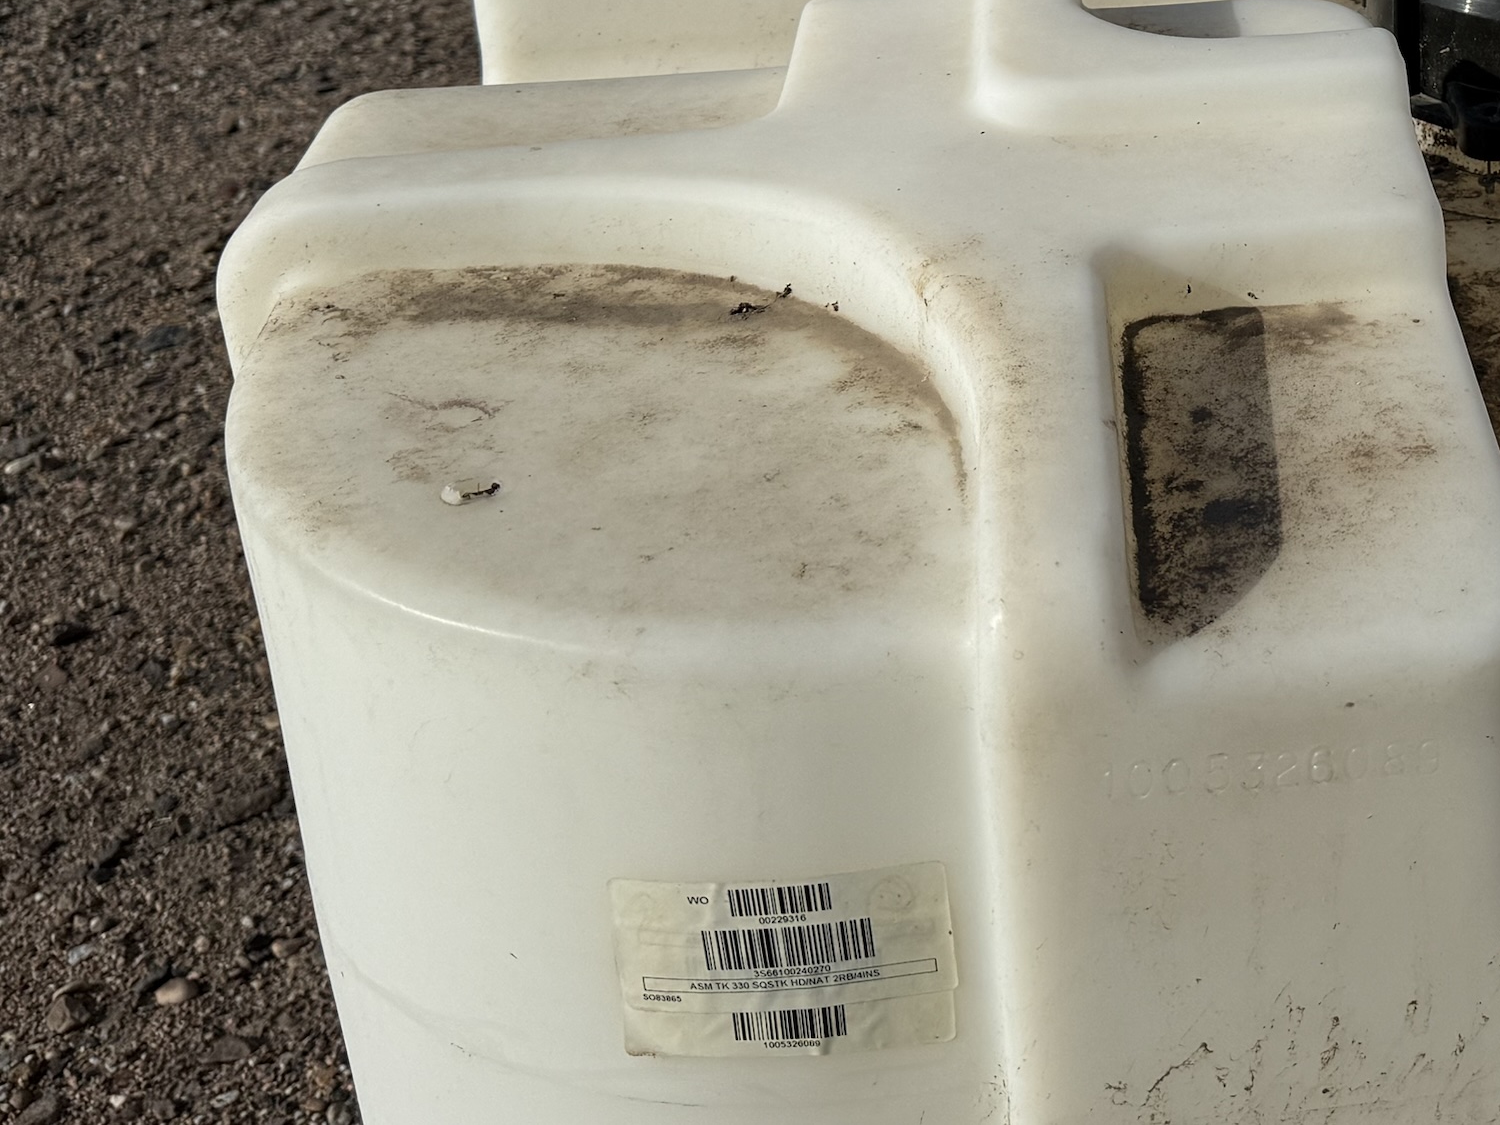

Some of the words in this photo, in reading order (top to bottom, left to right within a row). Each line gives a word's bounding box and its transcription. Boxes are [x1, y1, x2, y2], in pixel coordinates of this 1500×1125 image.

[687, 896, 709, 906] WO
[758, 914, 807, 925] 00229316
[690, 981, 714, 991] ASM
[715, 981, 730, 990] TK
[732, 980, 750, 990] 330
[752, 979, 789, 989] SQSTK
[790, 975, 831, 987] HD/NAT
[832, 969, 881, 983] 2RB/4INS
[642, 993, 683, 1003] SO83865
